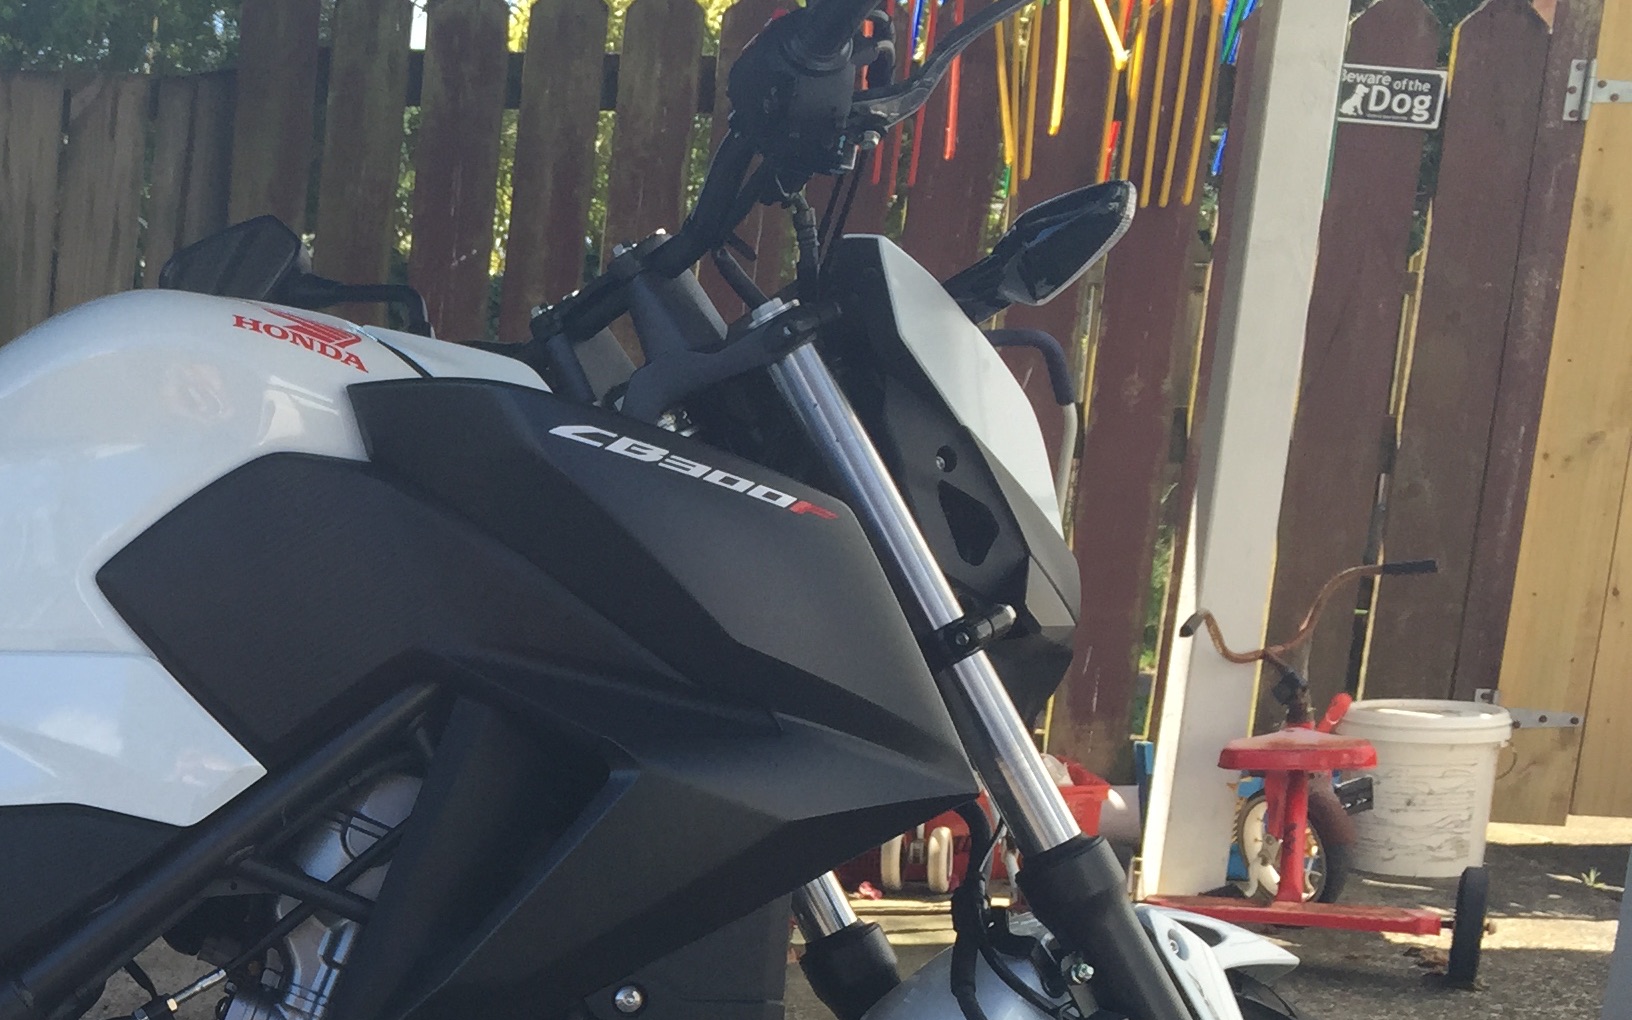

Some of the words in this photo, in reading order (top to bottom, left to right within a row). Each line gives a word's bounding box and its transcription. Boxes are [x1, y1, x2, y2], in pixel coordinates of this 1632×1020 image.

[1368, 85, 1432, 122] Dog
[1393, 79, 1408, 90] of
[1409, 79, 1432, 92] the
[232, 314, 369, 374] HONDA
[548, 425, 839, 520] CB300F
